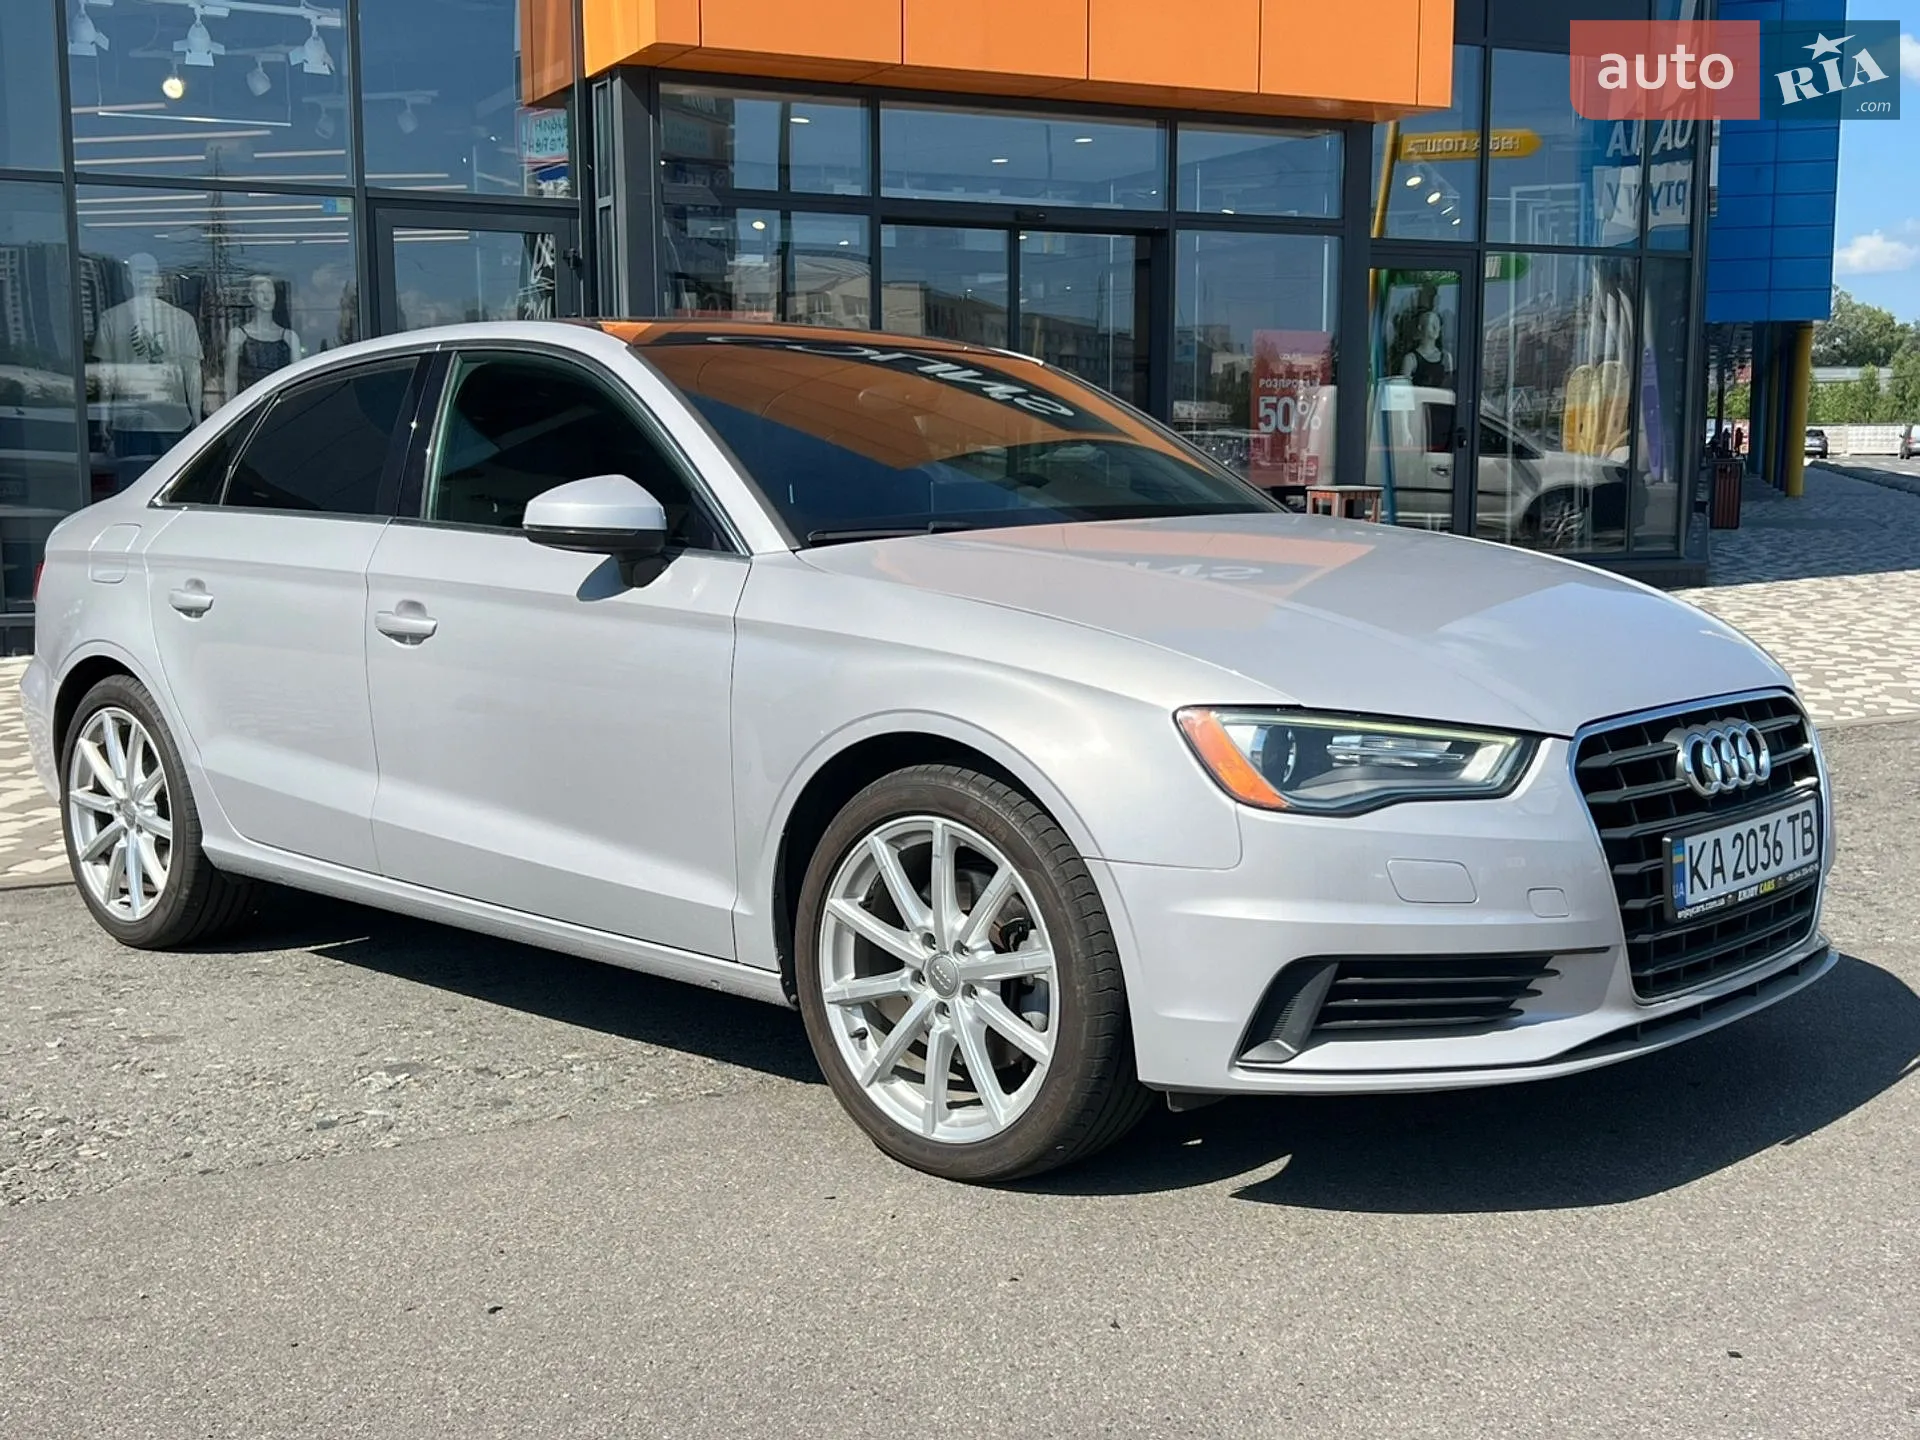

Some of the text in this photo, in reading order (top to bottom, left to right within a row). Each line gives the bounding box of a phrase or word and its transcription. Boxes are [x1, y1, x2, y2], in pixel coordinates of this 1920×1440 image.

[1259, 378, 1320, 389] РОЗПРО
[1258, 396, 1322, 433] 50%
[1689, 810, 1814, 894] KA 2036 TB
